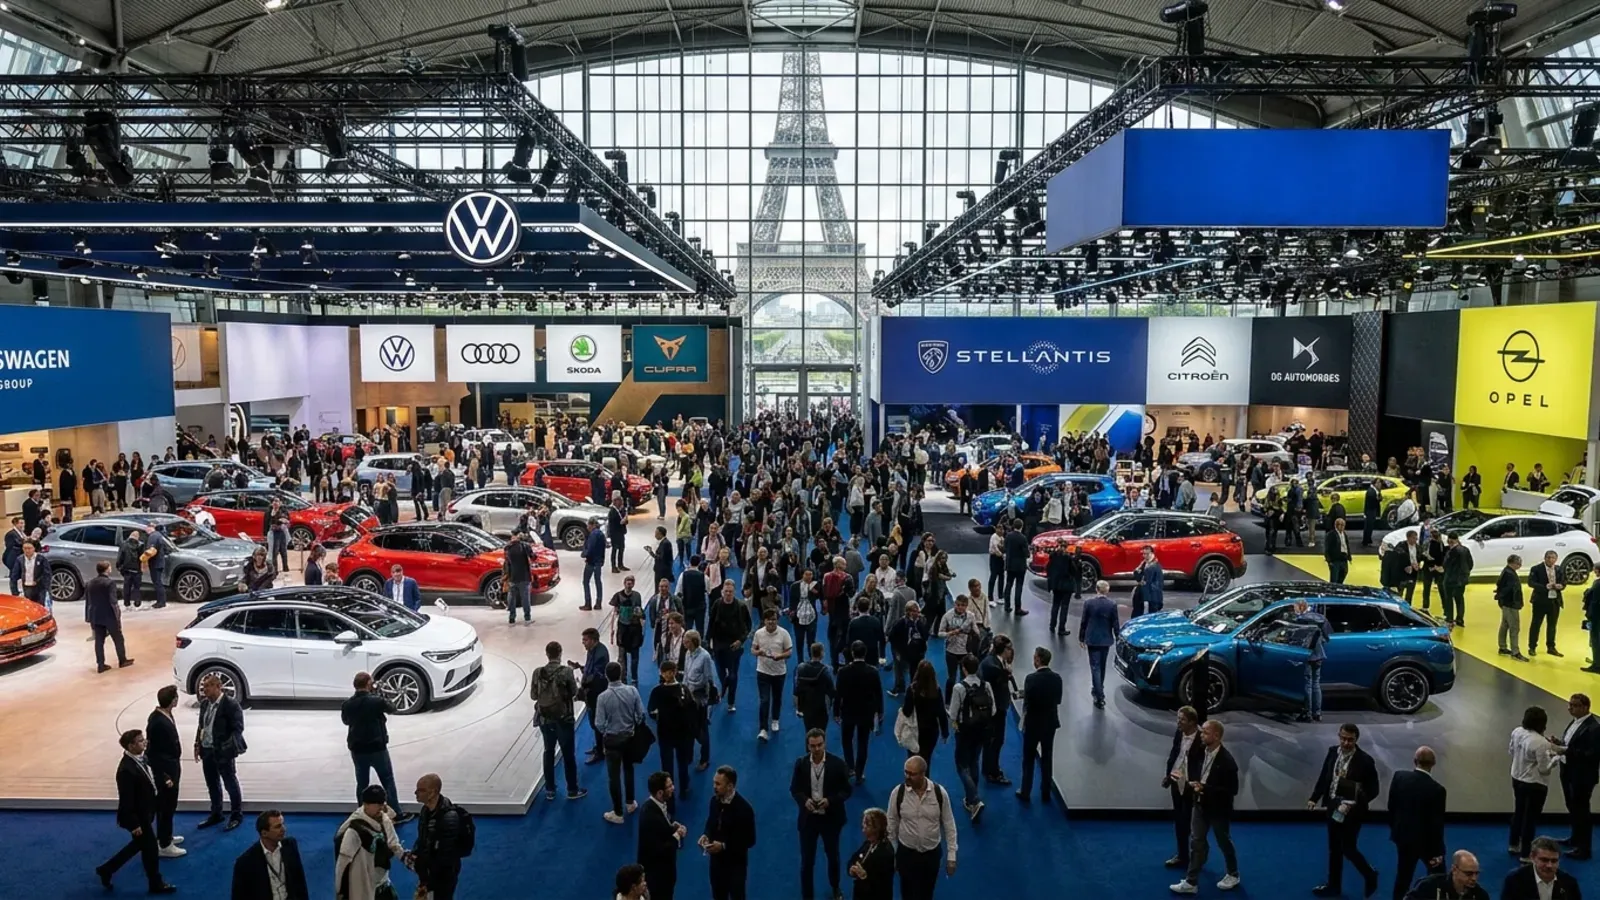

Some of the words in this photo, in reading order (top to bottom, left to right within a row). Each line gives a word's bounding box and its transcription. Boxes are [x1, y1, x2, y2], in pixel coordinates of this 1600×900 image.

[956, 350, 1111, 363] STELLANTIS
[566, 366, 602, 374] SKODA
[1489, 391, 1549, 408] OPEL
